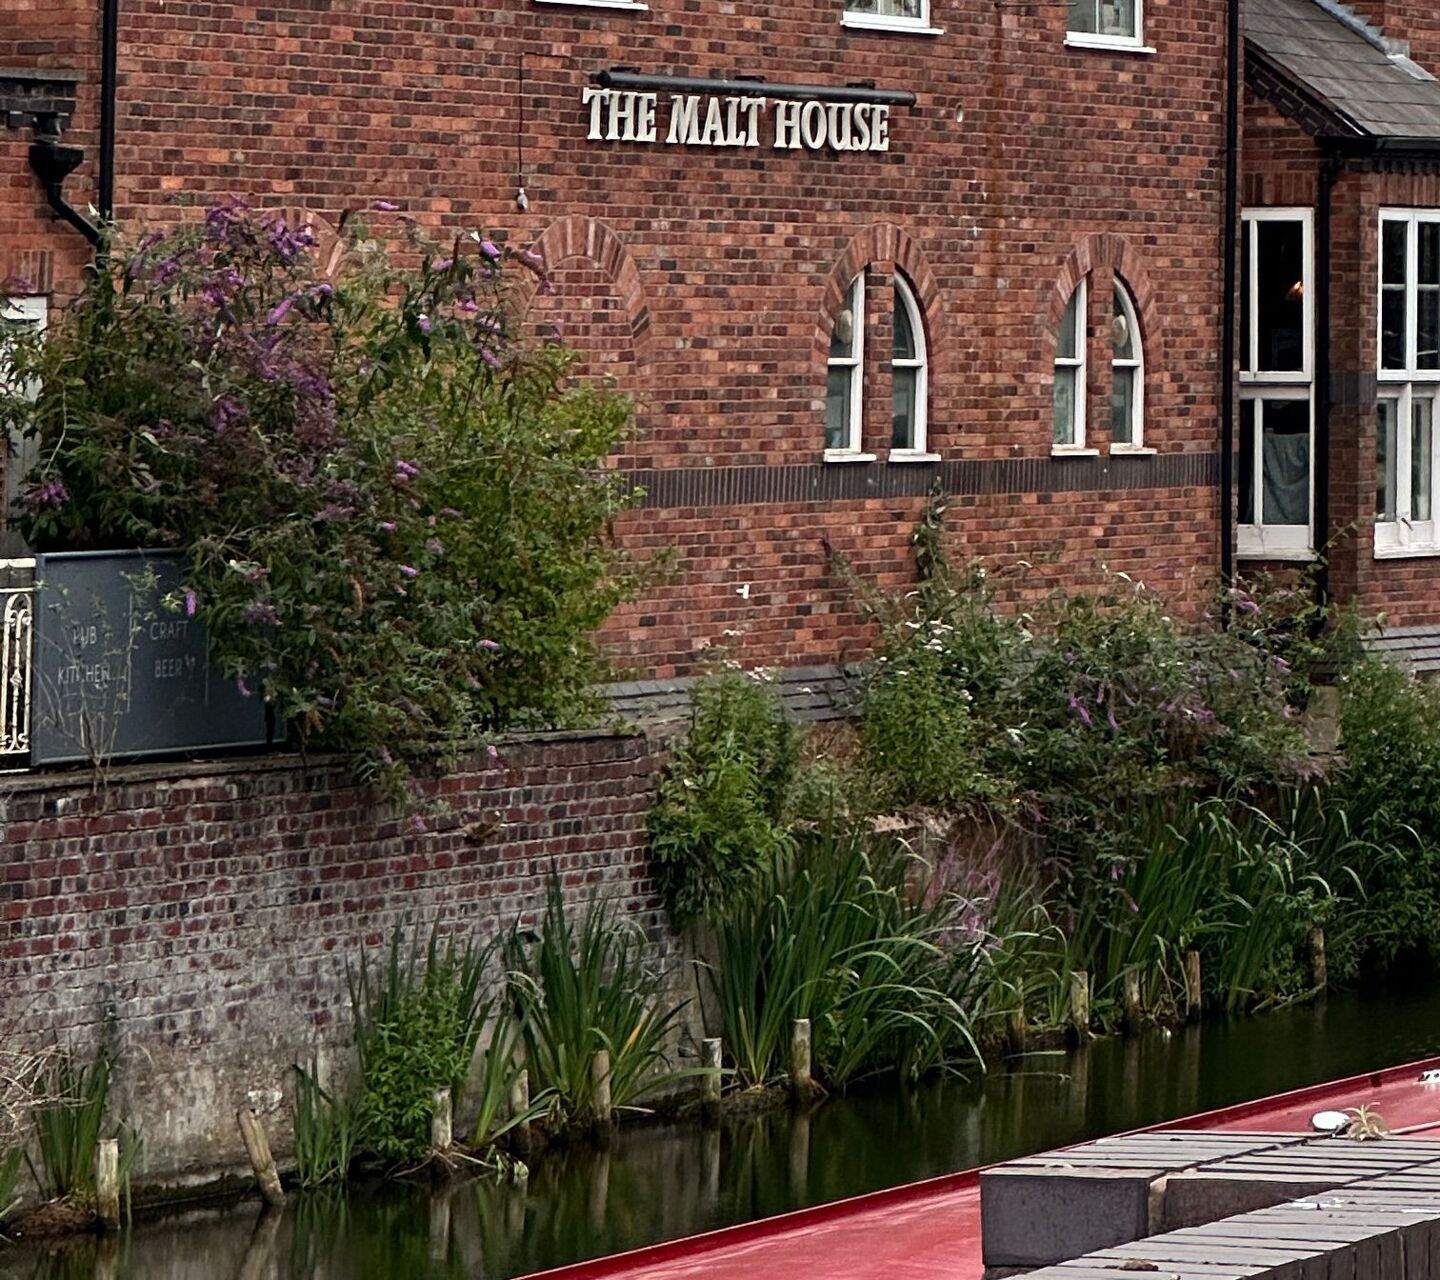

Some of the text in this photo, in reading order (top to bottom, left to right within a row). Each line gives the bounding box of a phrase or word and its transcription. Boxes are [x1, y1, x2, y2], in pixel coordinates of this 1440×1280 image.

[583, 87, 890, 152] THE MALT HOUSE
[150, 620, 189, 640] CRAFT
